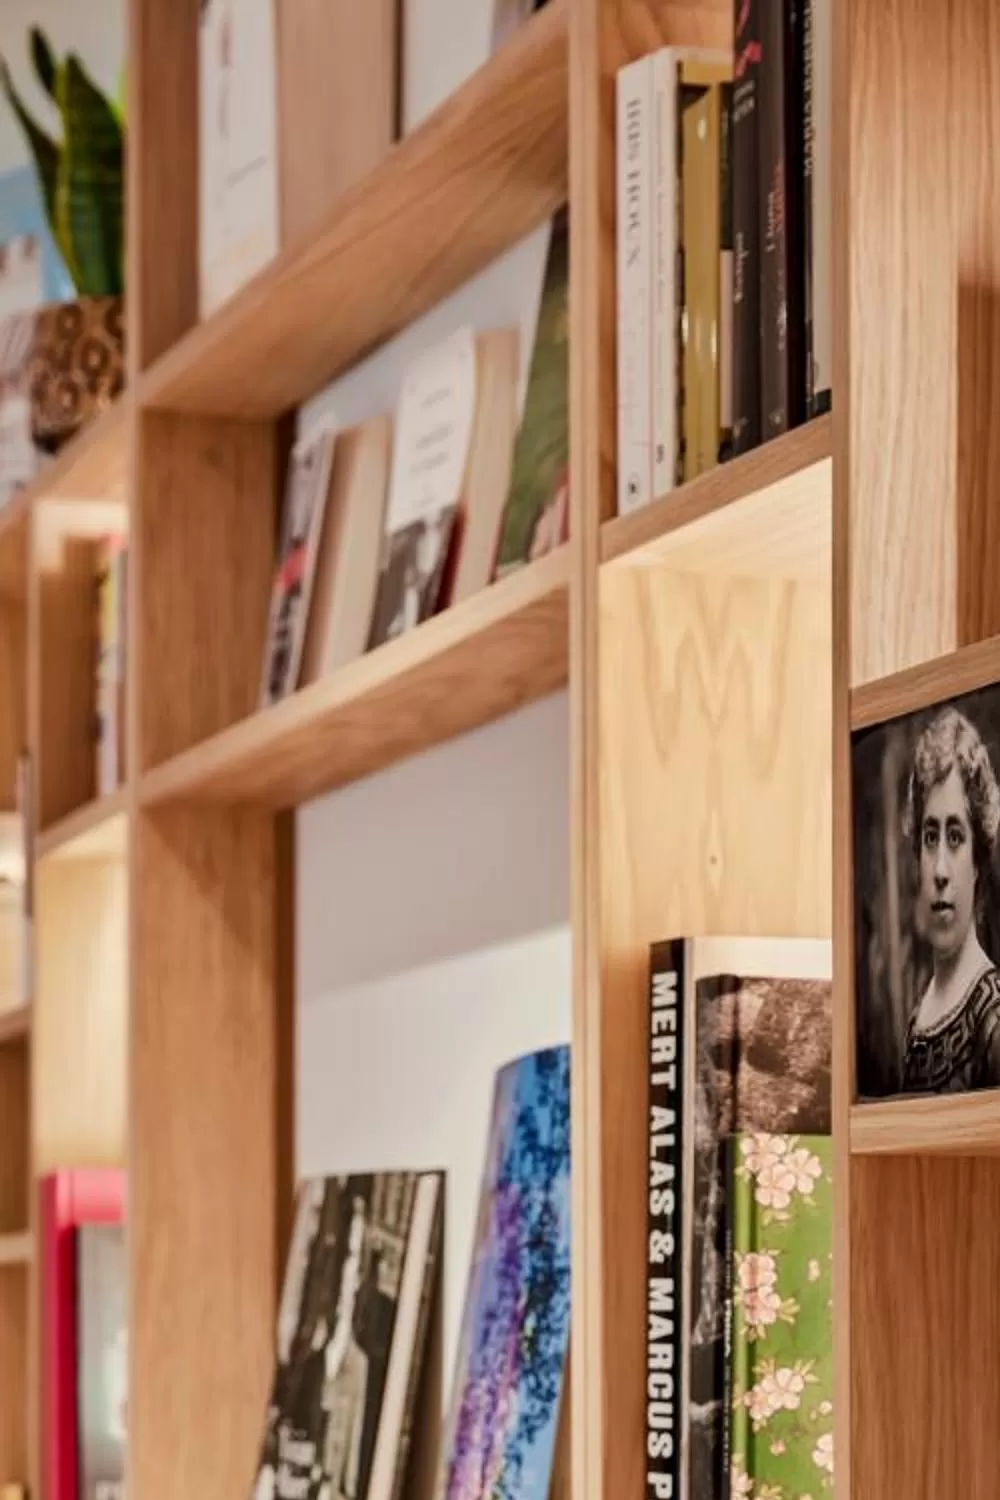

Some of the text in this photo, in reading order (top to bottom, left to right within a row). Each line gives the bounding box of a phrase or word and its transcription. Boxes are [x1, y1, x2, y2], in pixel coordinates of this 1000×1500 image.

[651, 969, 678, 1091] MERT
[649, 1104, 676, 1218] ALAS
[649, 1229, 675, 1263] &
[647, 1276, 674, 1460] MARCUS
